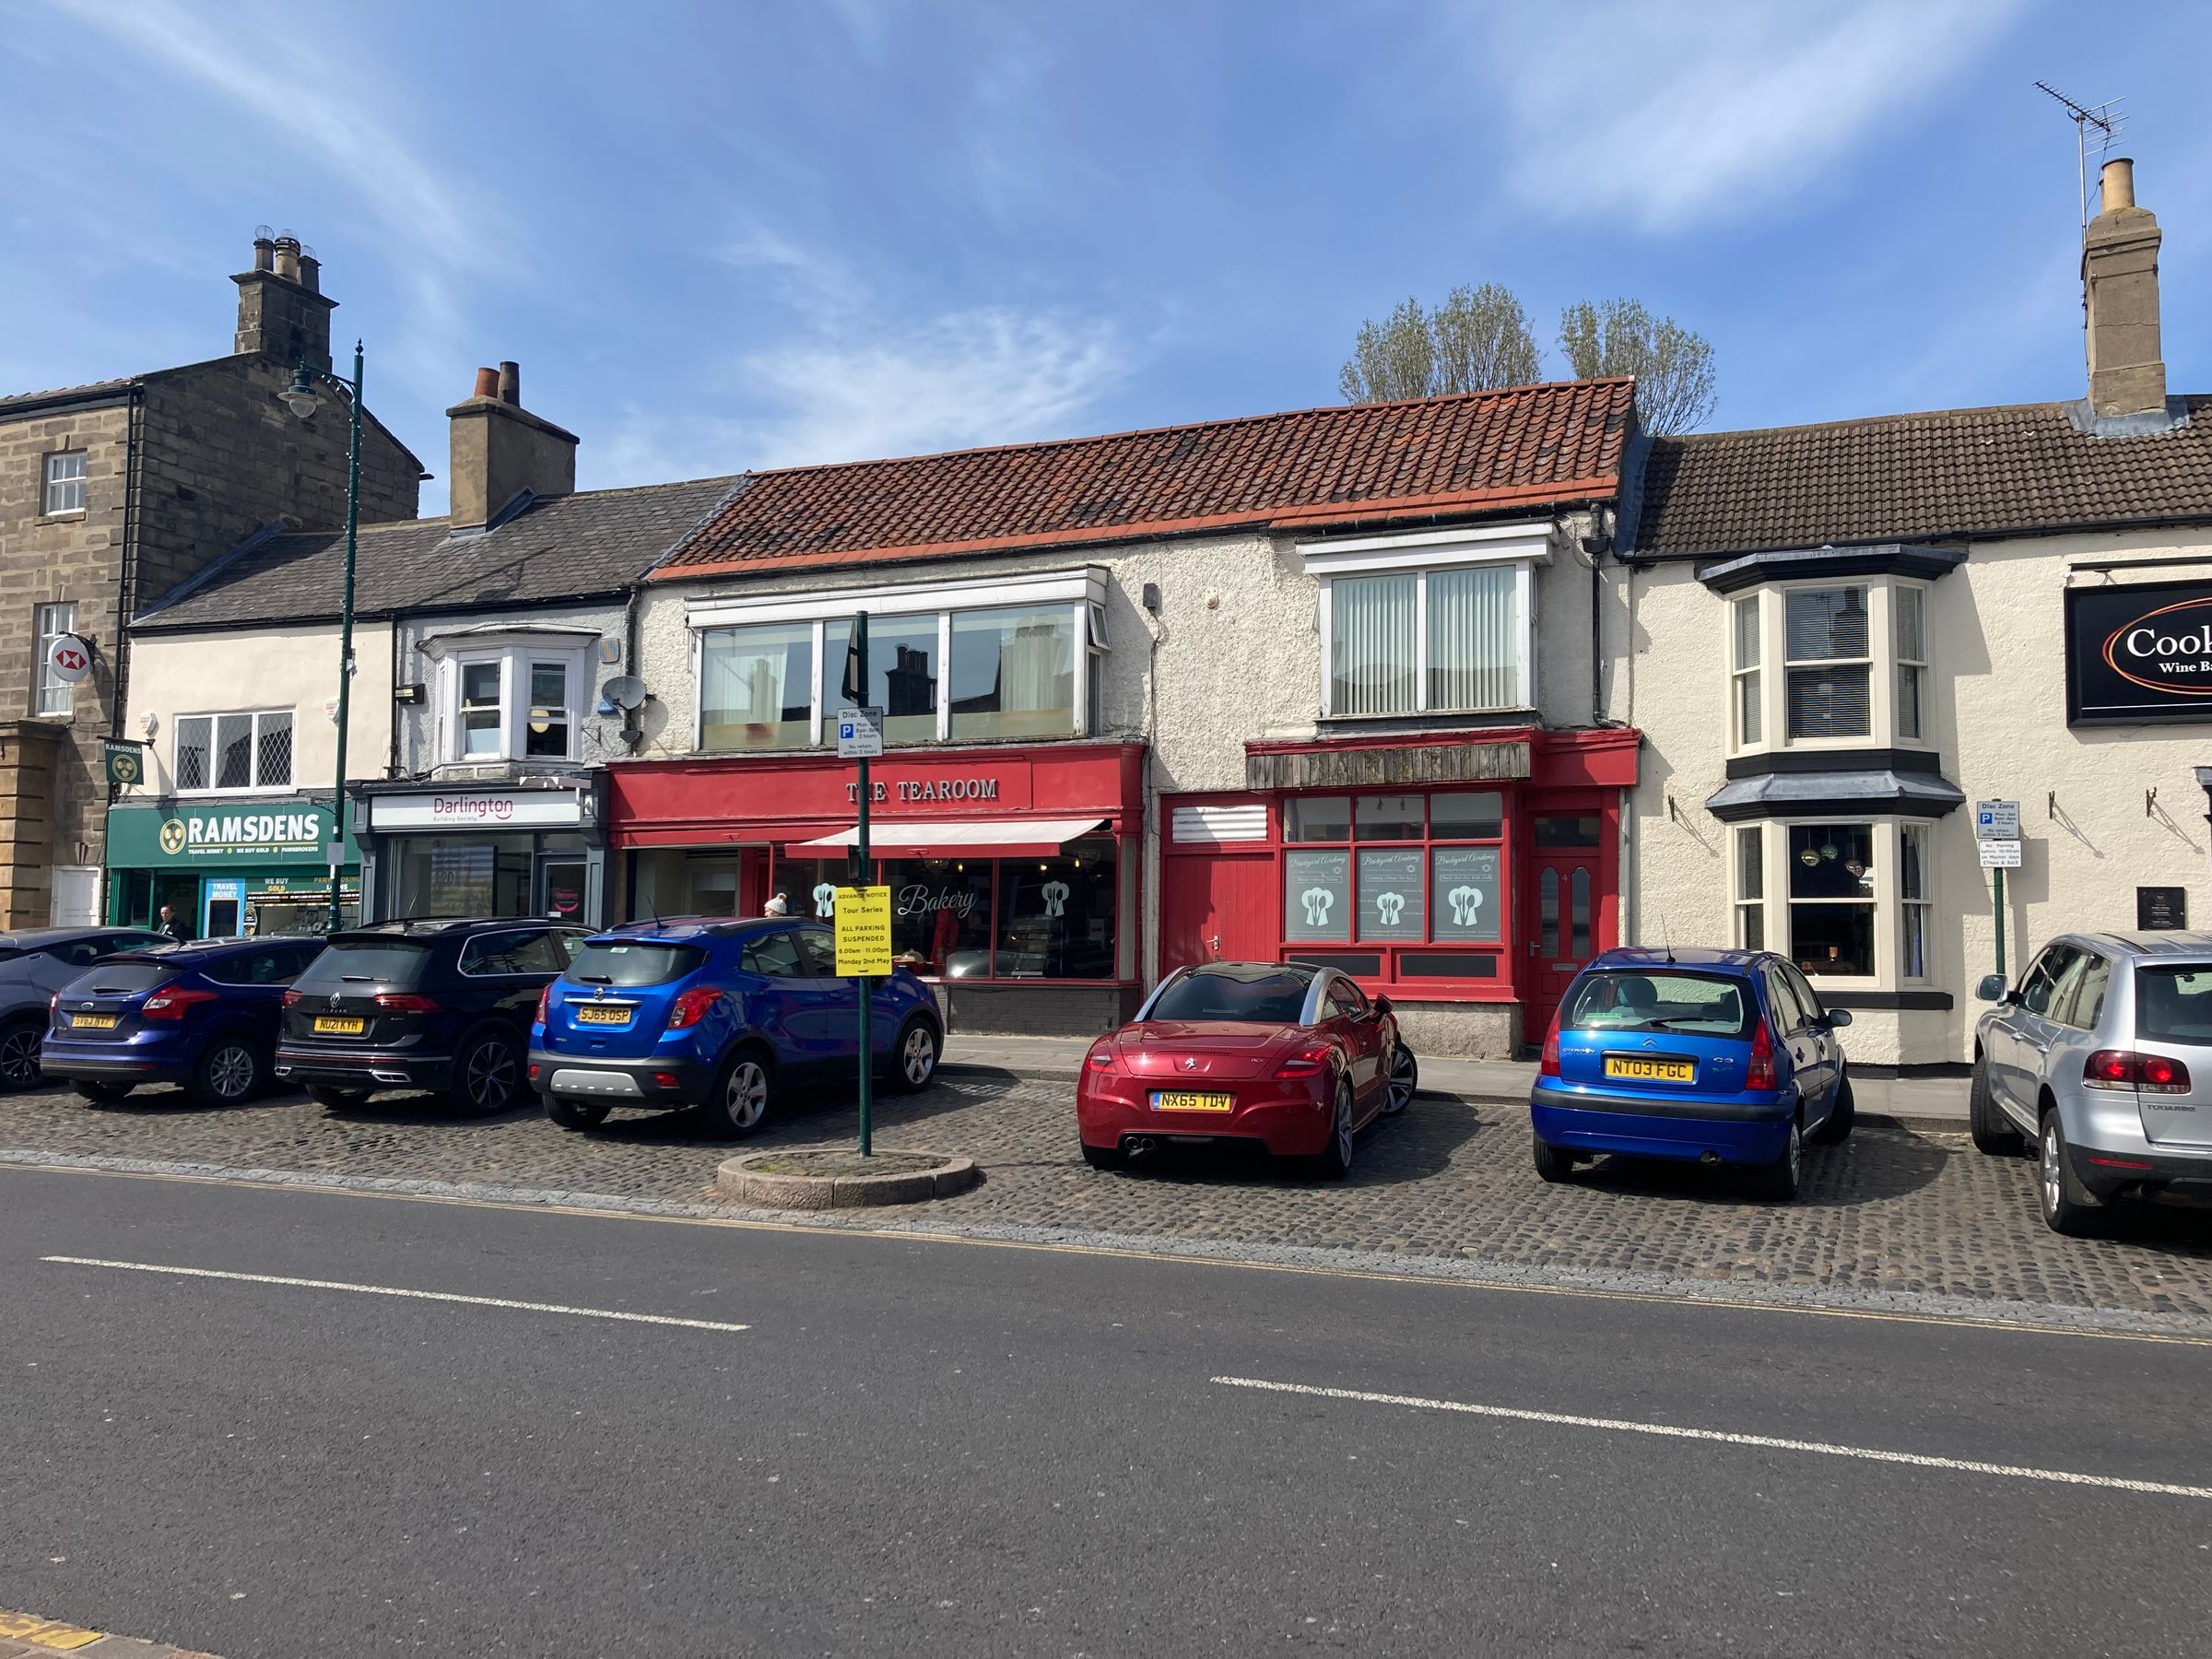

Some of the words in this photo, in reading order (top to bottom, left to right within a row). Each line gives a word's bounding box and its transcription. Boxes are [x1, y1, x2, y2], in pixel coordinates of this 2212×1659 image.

[2159, 662, 2196, 673] Wine
[2199, 661, 2212, 672] B
[842, 725, 852, 737] P
[105, 744, 142, 754] RAMSDENS
[846, 782, 886, 802] TE
[897, 779, 997, 801] TEAROOM
[434, 796, 513, 818] Darlington
[1983, 815, 1990, 823] P
[188, 814, 320, 843] RAMSDENS
[898, 884, 977, 919] Bakery
[581, 1008, 606, 1020] SJ65
[609, 1009, 629, 1021] OSP
[320, 1019, 339, 1030] NU21
[339, 1020, 358, 1030] KYH
[1613, 1061, 1652, 1076] NT03
[1656, 1063, 1687, 1078] FGC
[1161, 1094, 1197, 1107] NX65
[1202, 1094, 1228, 1108] TDV
